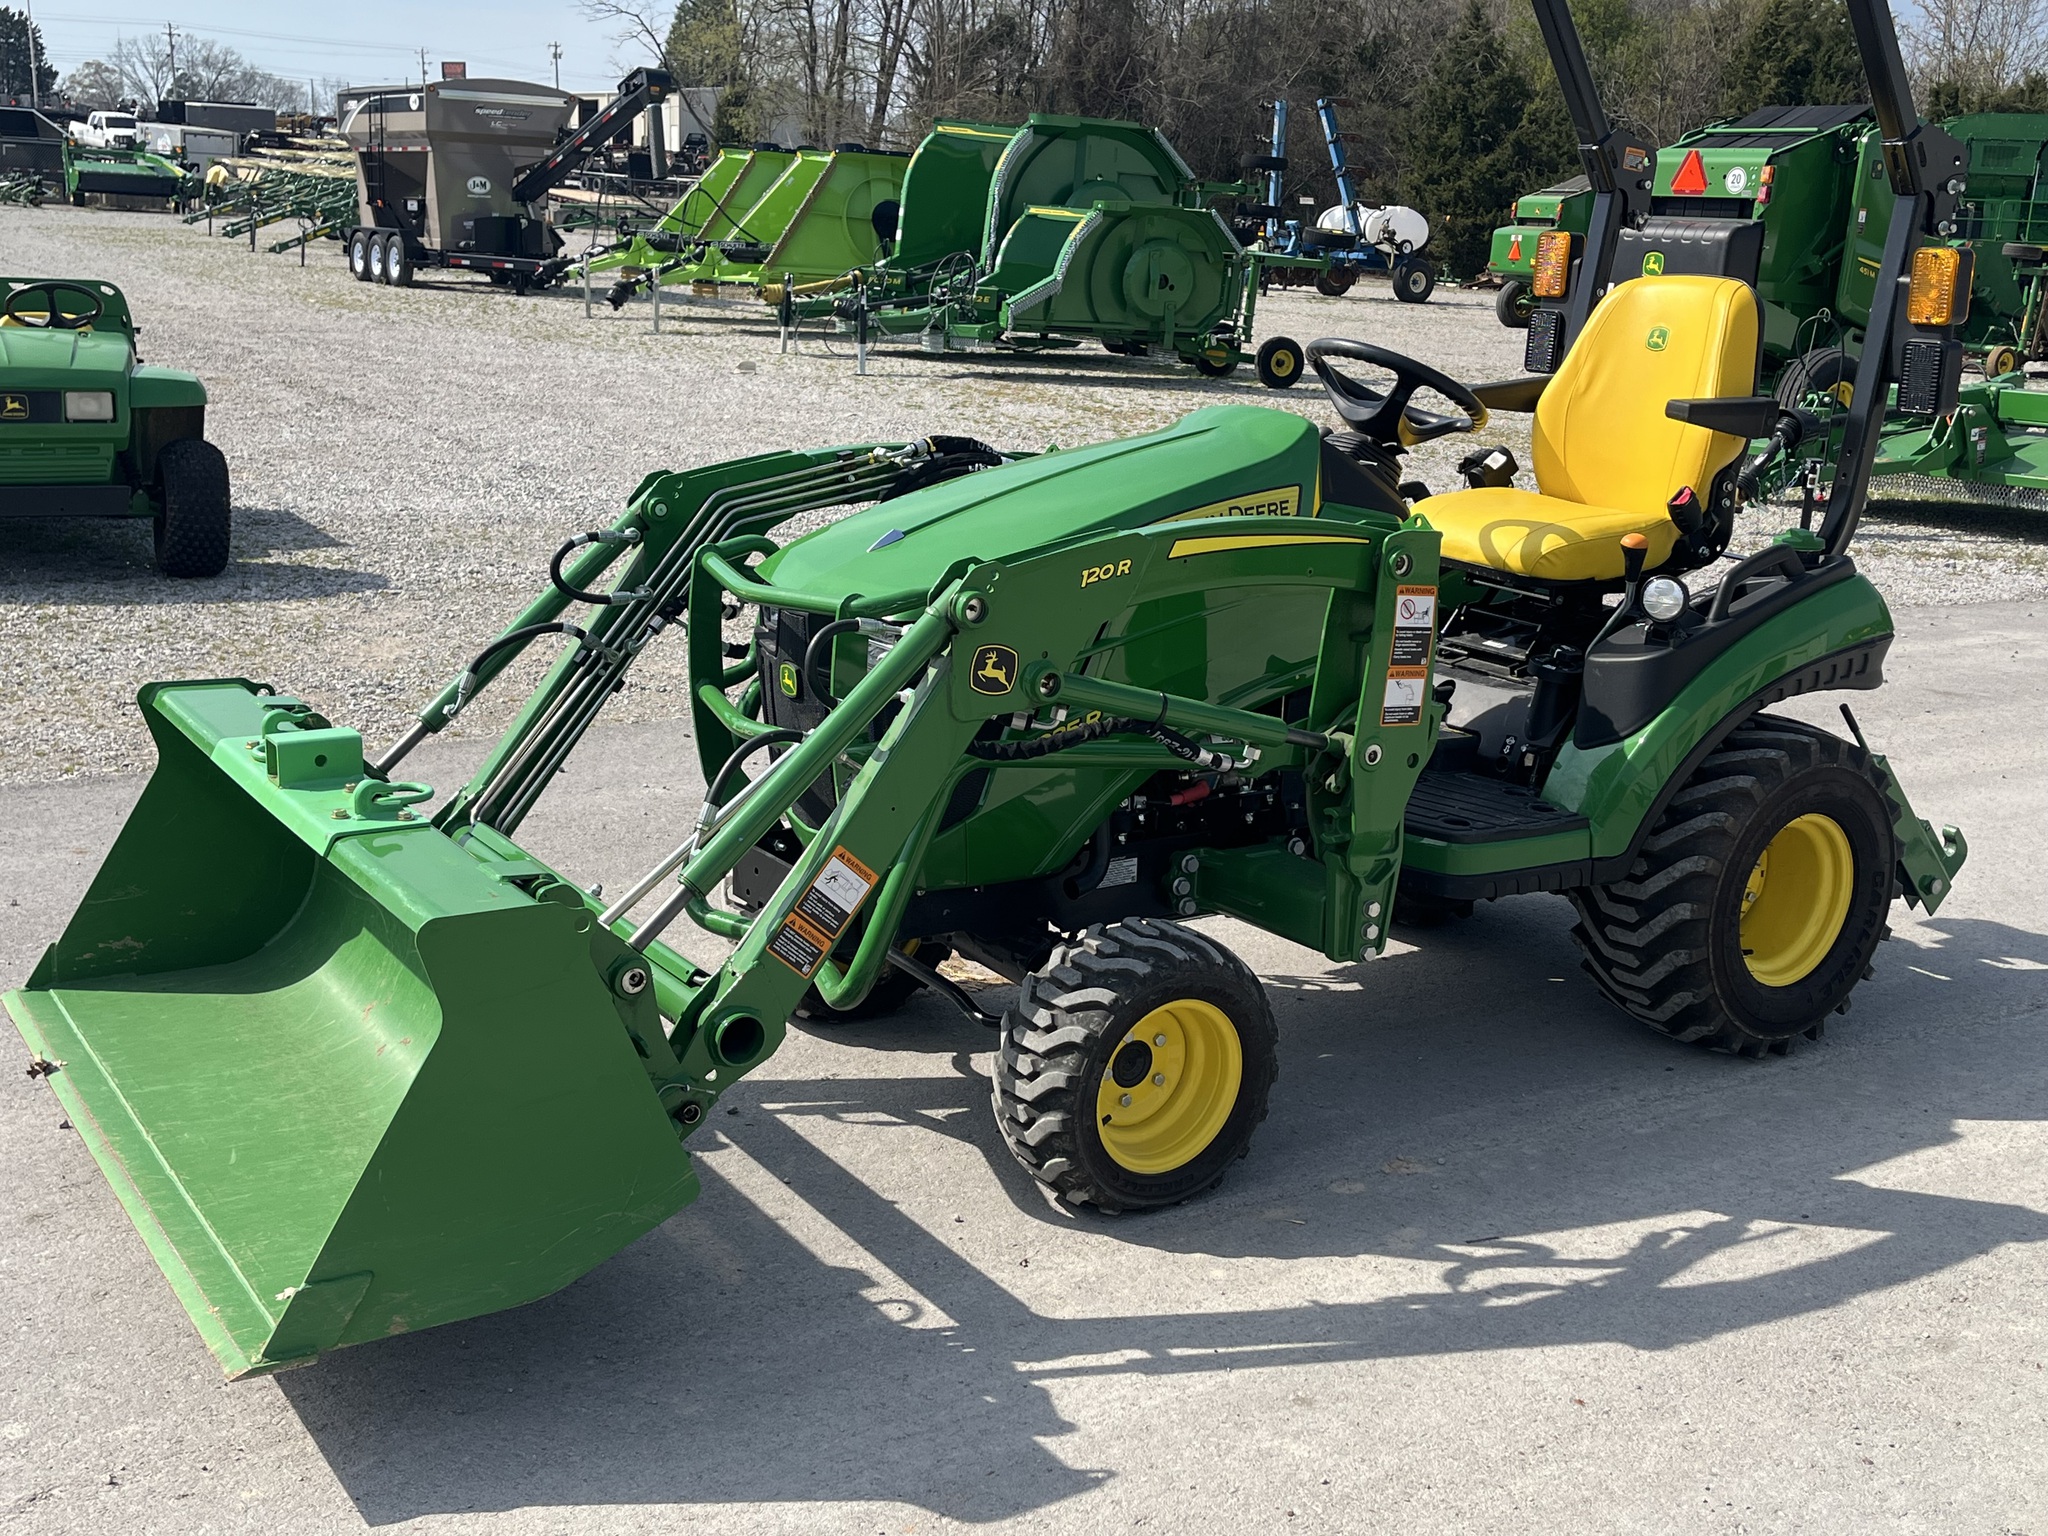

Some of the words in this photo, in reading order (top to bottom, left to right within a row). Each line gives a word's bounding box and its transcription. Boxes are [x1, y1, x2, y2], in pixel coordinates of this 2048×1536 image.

[469, 180, 487, 190] J&M
[1731, 174, 1741, 184] 20
[845, 855, 873, 881] WARNING
[797, 923, 825, 948] WARNING
